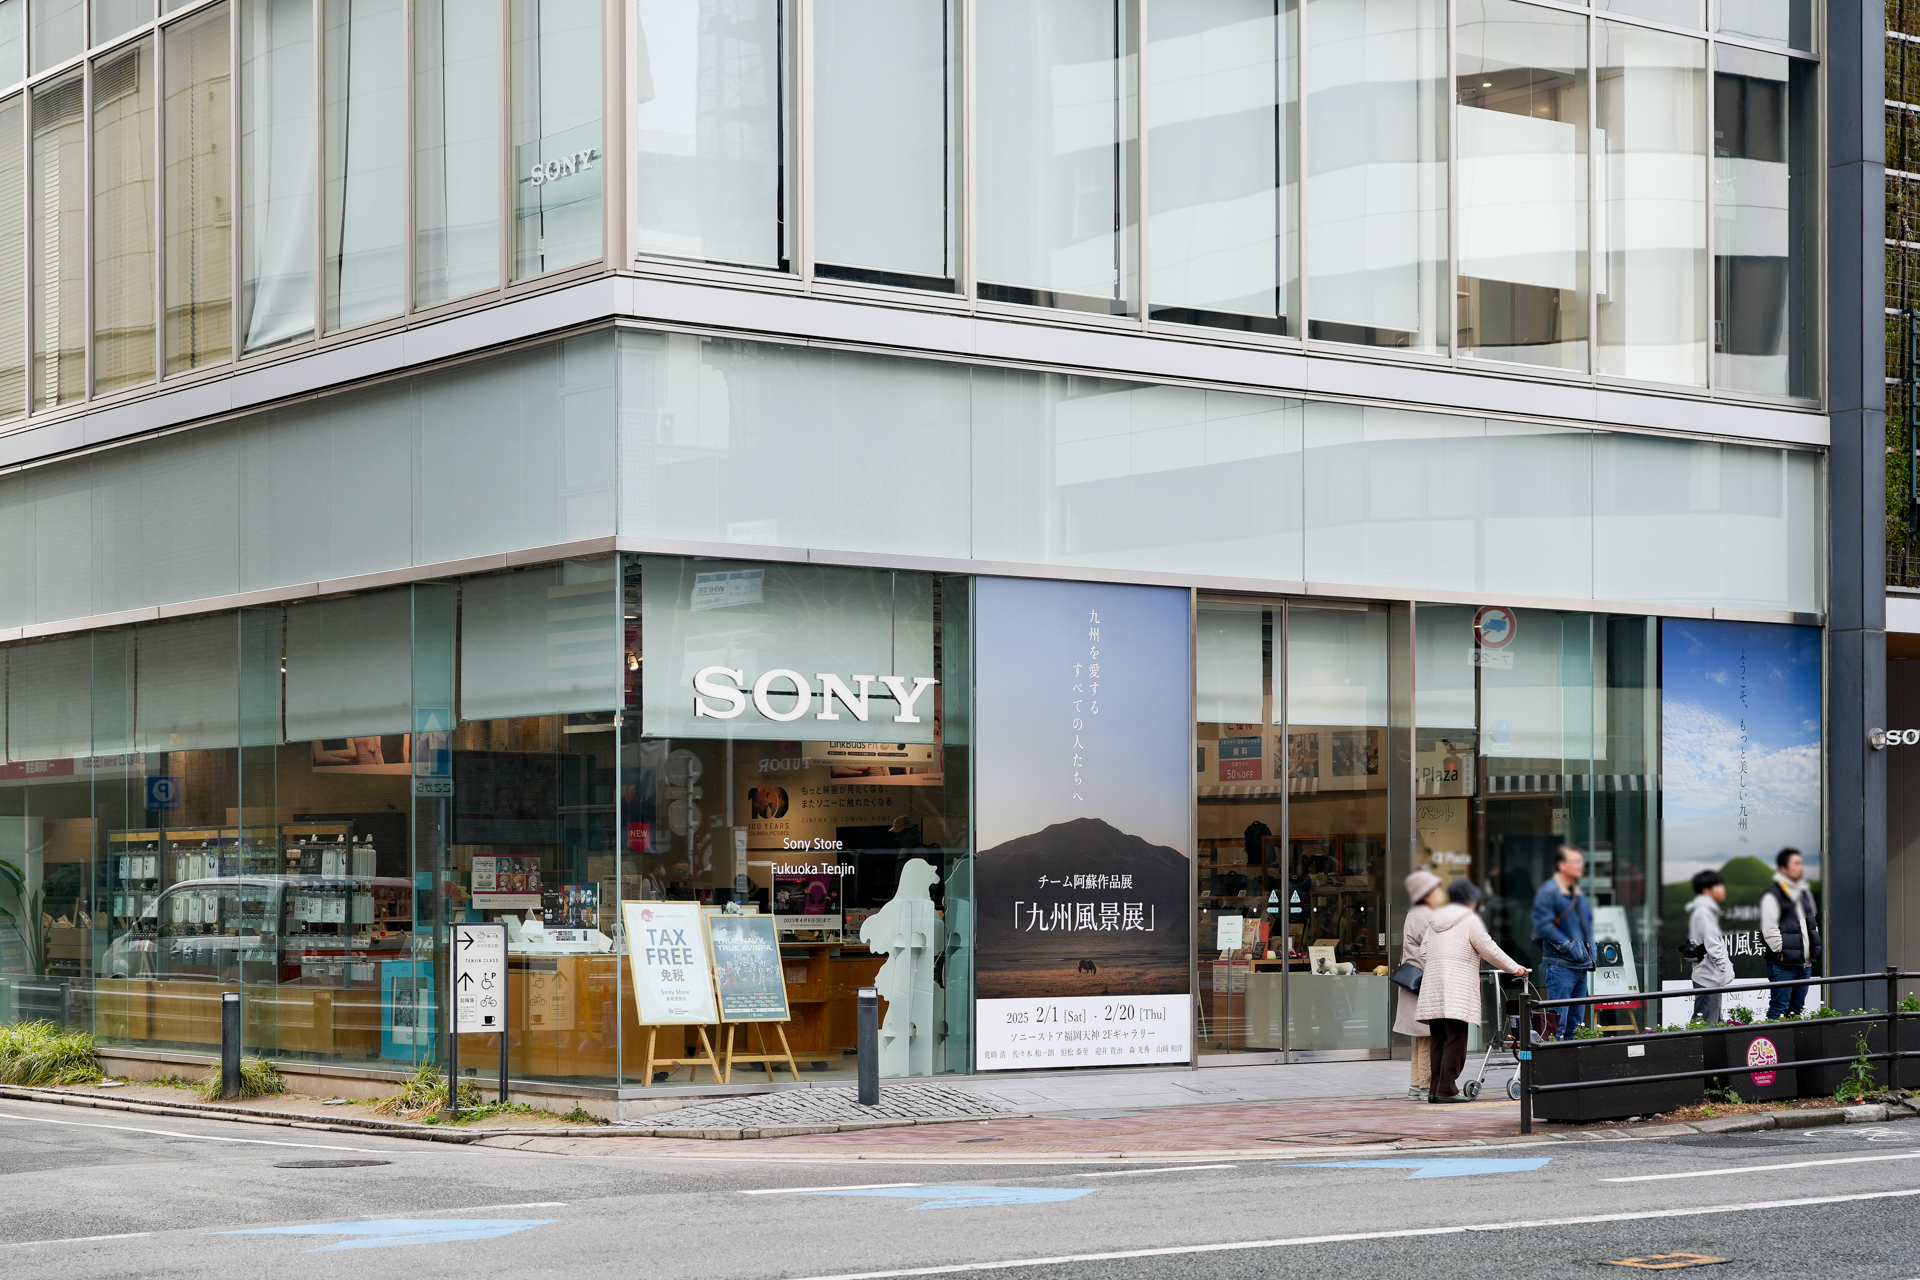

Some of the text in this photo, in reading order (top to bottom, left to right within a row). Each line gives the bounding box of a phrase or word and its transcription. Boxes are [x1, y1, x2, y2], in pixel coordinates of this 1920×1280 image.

[531, 148, 597, 186] SONY
[1088, 608, 1101, 715] 九州を愛する
[693, 665, 937, 723] SONY
[1072, 662, 1084, 801] すべての人たちへ
[1886, 729, 1920, 745] SO
[1232, 747, 1248, 756] 無料
[1226, 769, 1254, 779] 50%OFF
[1422, 766, 1459, 782] Plaza
[801, 798, 892, 809] またソニーに触れたくなる
[630, 829, 648, 837] NEW
[783, 837, 843, 851] Sony Store
[771, 862, 855, 877] Fukuoka Tenjin
[1038, 874, 1133, 890] チーム阿蘇作品展
[1014, 901, 1155, 932] 「九州風景展」
[646, 929, 687, 946] TAX
[717, 944, 741, 952] TRUE
[646, 948, 694, 965] FREE
[491, 972, 497, 980] P
[661, 969, 685, 982] 免税
[1006, 1012, 1029, 1024] 2025
[1036, 1004, 1058, 1024] 2/1
[1063, 1009, 1086, 1023] [Sat]
[1104, 1003, 1135, 1023] 2/20
[1139, 1007, 1166, 1021] [Thu]
[1010, 1029, 1156, 1043] ソニーストア福岡天神 2Fギャラリー
[1012, 1049, 1033, 1058] 佐々木
[1129, 1046, 1135, 1054] 森
